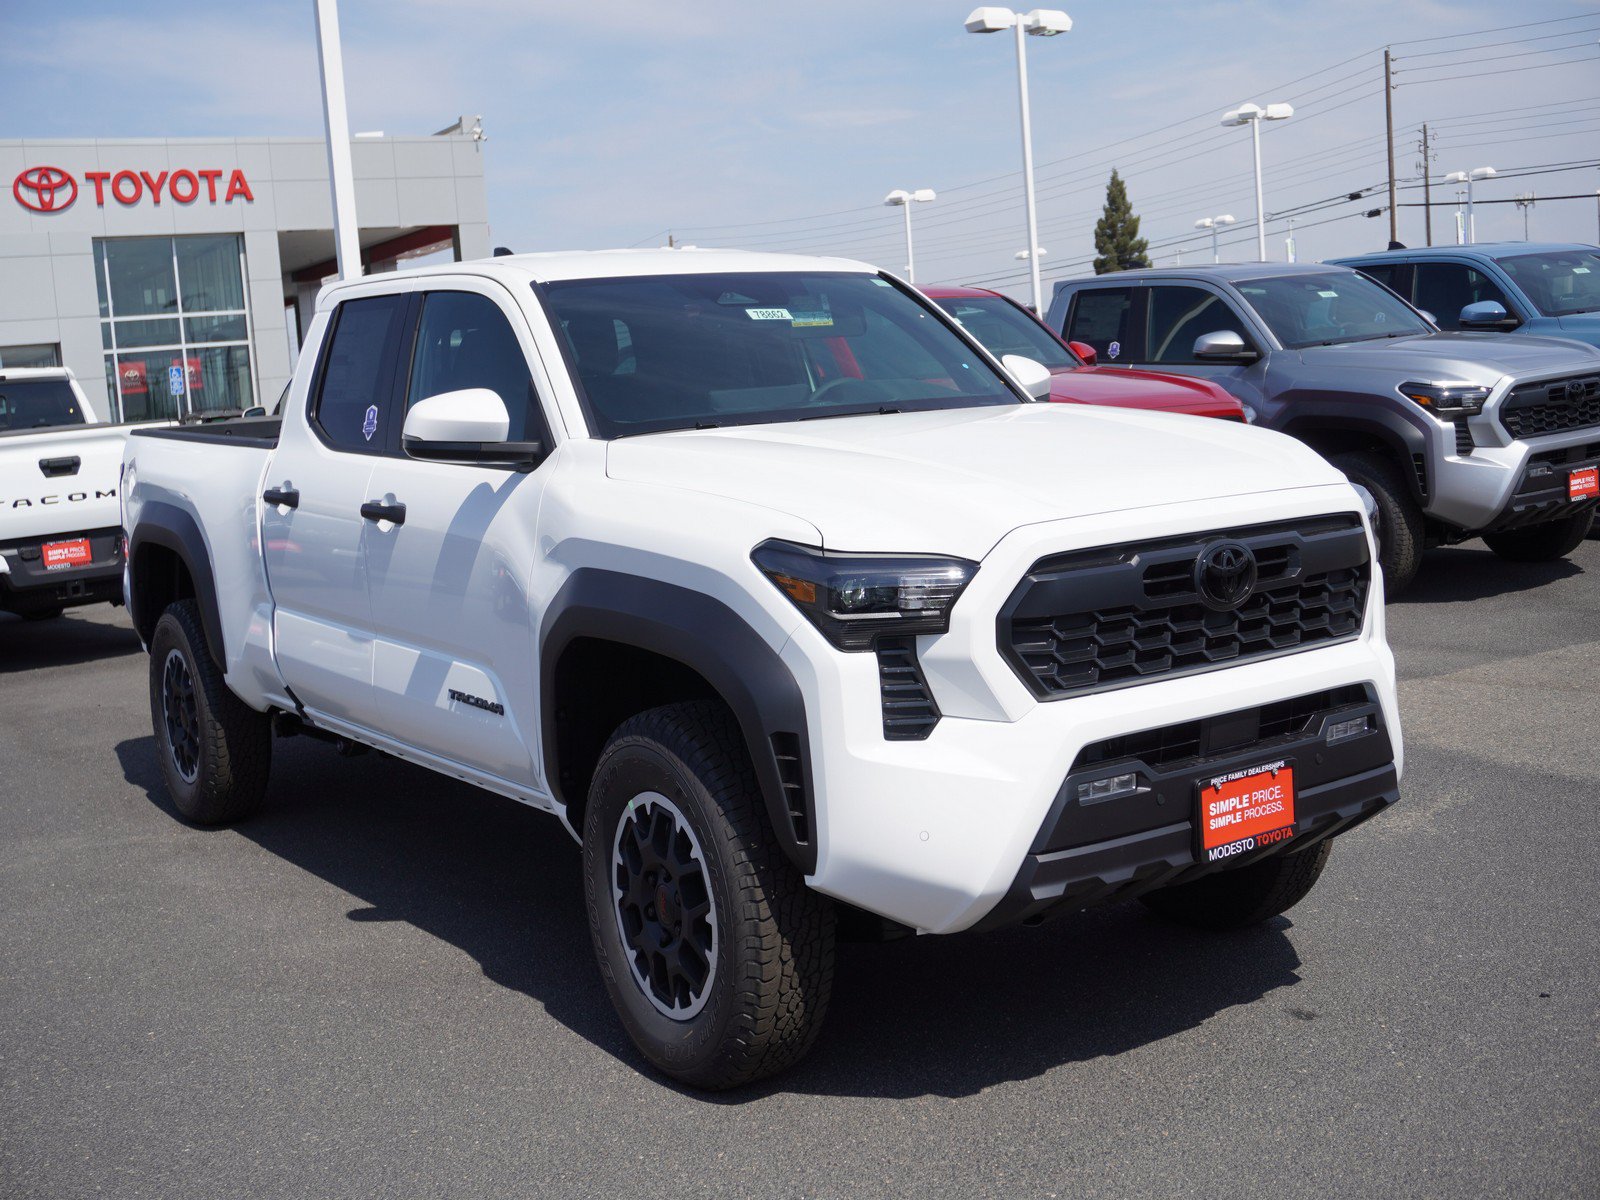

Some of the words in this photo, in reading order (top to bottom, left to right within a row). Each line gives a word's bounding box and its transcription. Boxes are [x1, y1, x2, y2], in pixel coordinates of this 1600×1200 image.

[85, 169, 254, 206] TOYOTA
[753, 310, 787, 319] 78862
[0, 489, 116, 508] ACOM
[448, 688, 505, 716] TACOMA
[1210, 775, 1227, 786] PRICE
[1228, 770, 1247, 781] FAMILY
[1248, 760, 1285, 776] DEALERSHIPS
[1209, 794, 1249, 816] SIMPLE
[1252, 785, 1284, 805] PRICE.
[1209, 811, 1243, 830] SIMPLE
[1244, 800, 1285, 820] PROCESS.
[1208, 837, 1255, 861] MODESTO
[1256, 827, 1294, 846] TOYOTA
